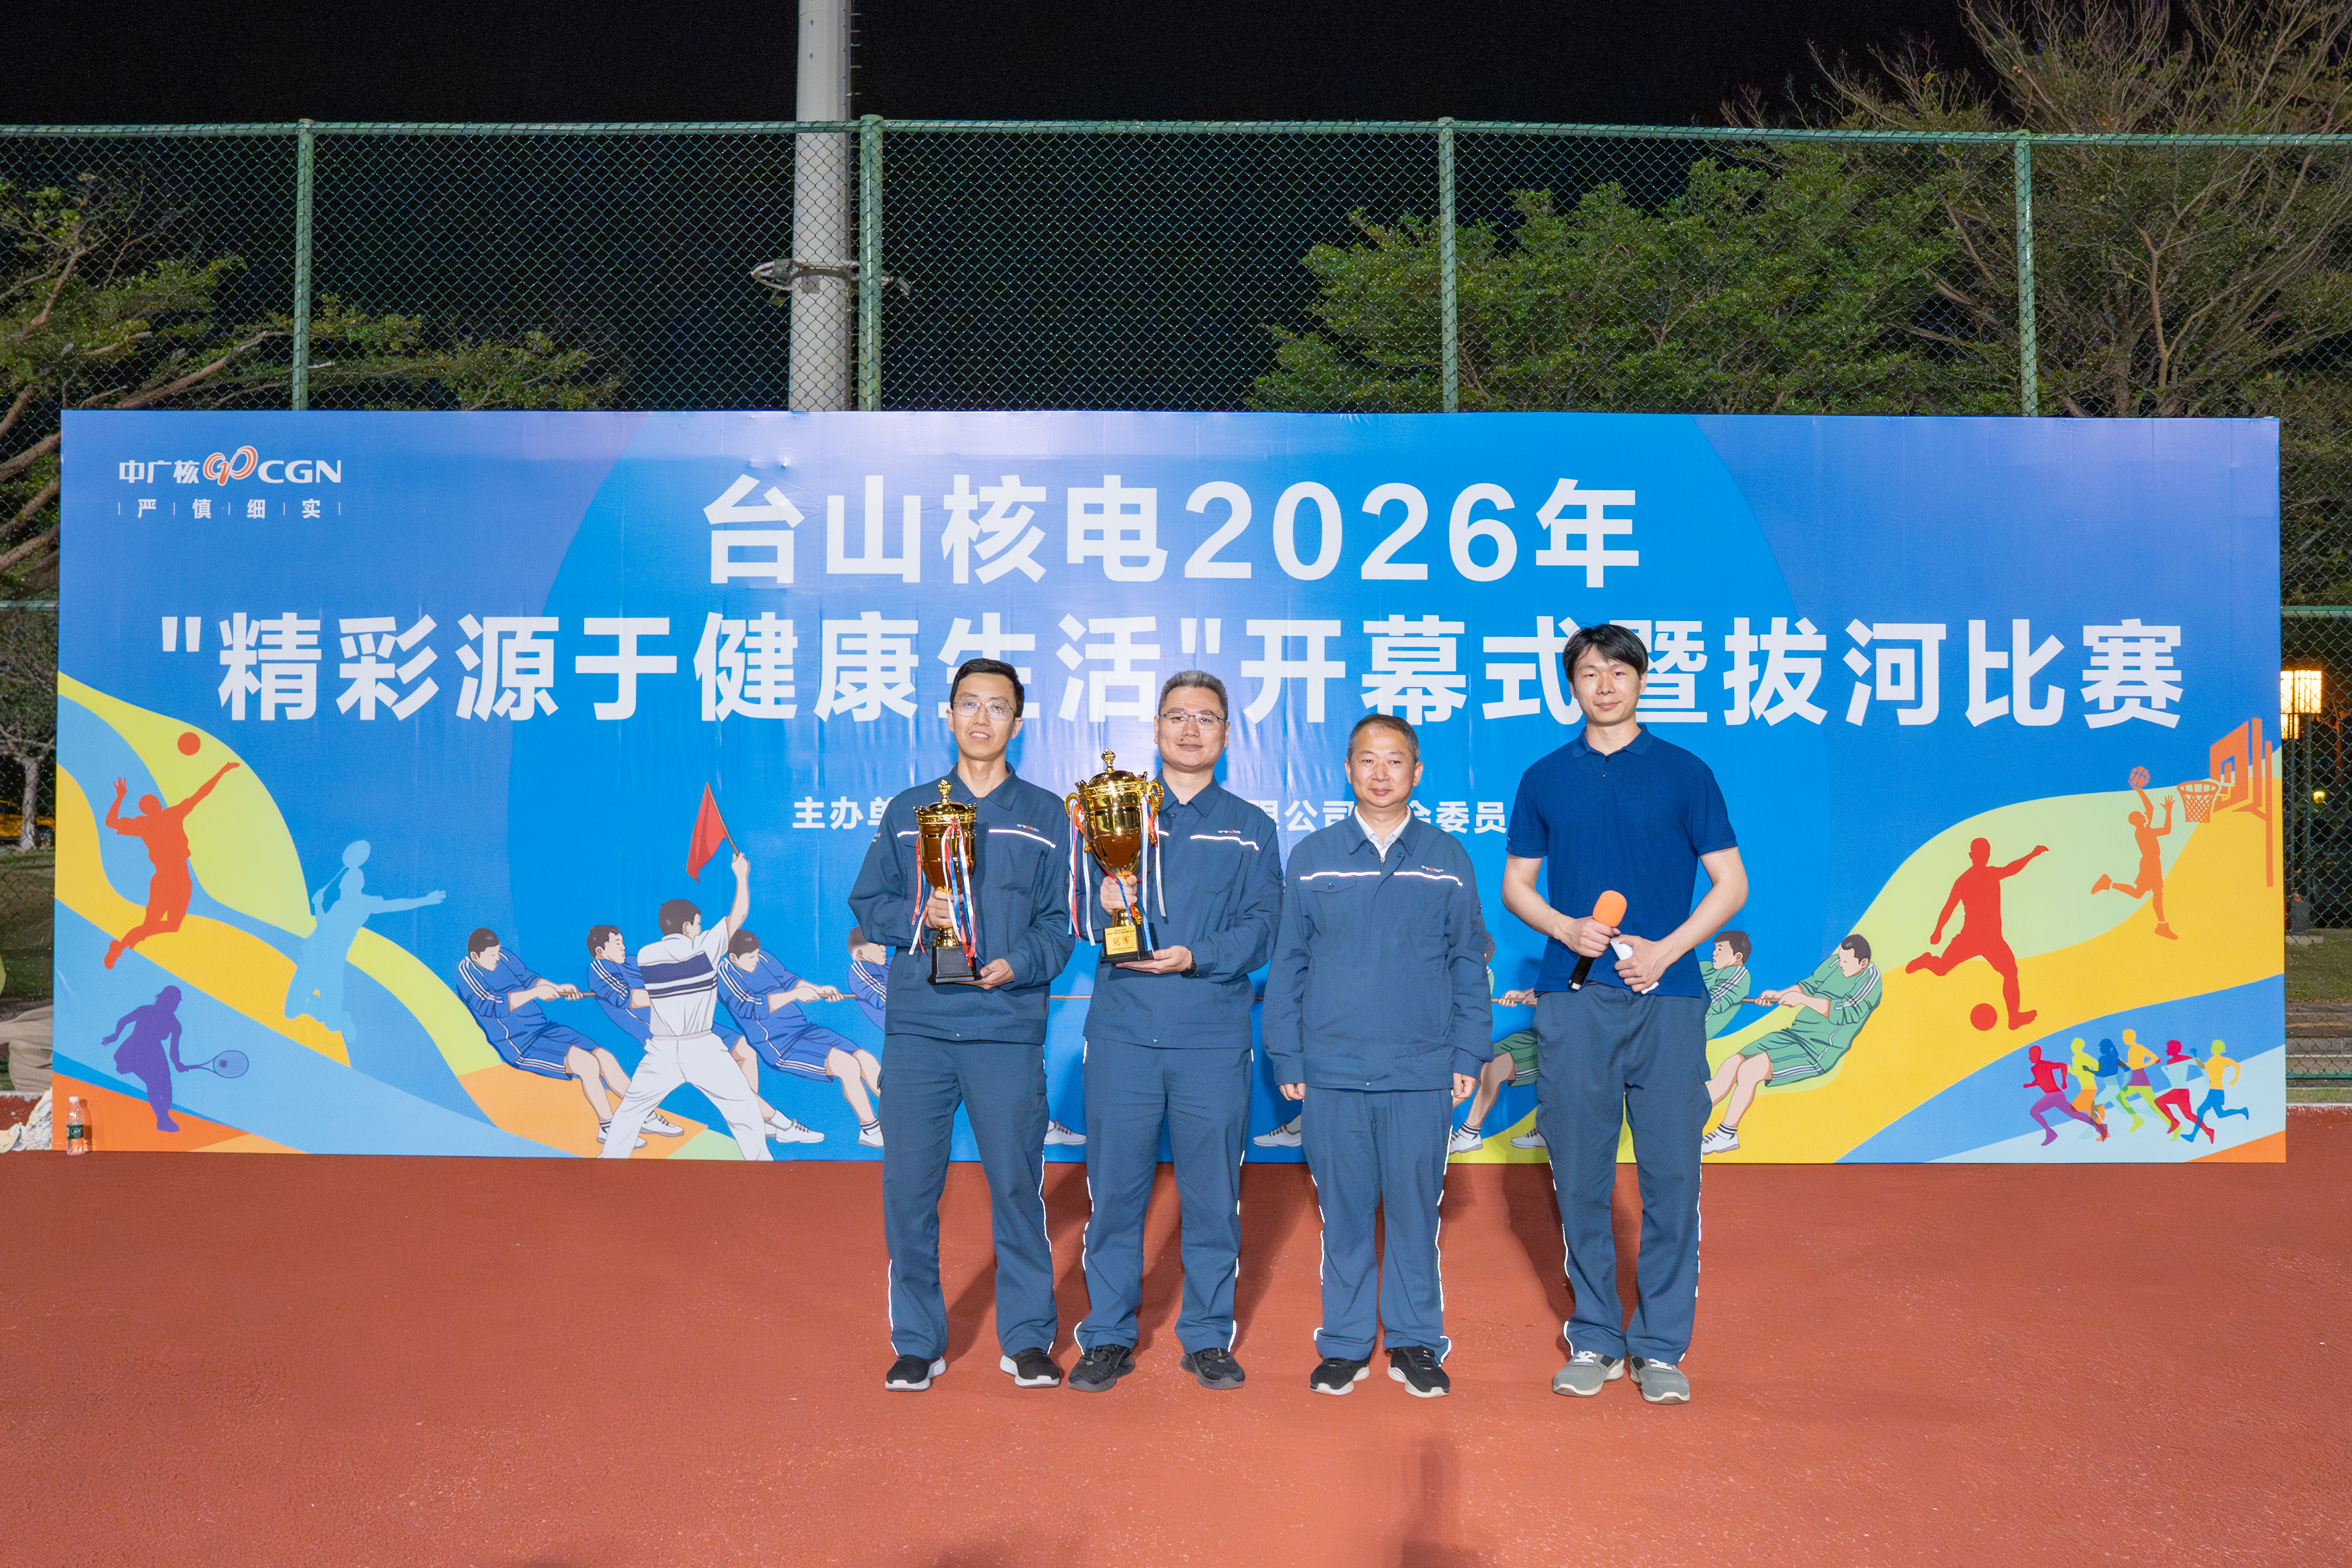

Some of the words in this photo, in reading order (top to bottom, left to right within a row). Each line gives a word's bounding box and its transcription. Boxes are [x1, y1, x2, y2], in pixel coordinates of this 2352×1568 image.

[119, 460, 200, 484] 中广核
[258, 460, 341, 484] CGN
[138, 499, 157, 518] 严
[192, 499, 212, 519] 慎
[247, 499, 266, 519] 细
[302, 499, 321, 519] 实
[703, 474, 1639, 588] 台山核电2026年
